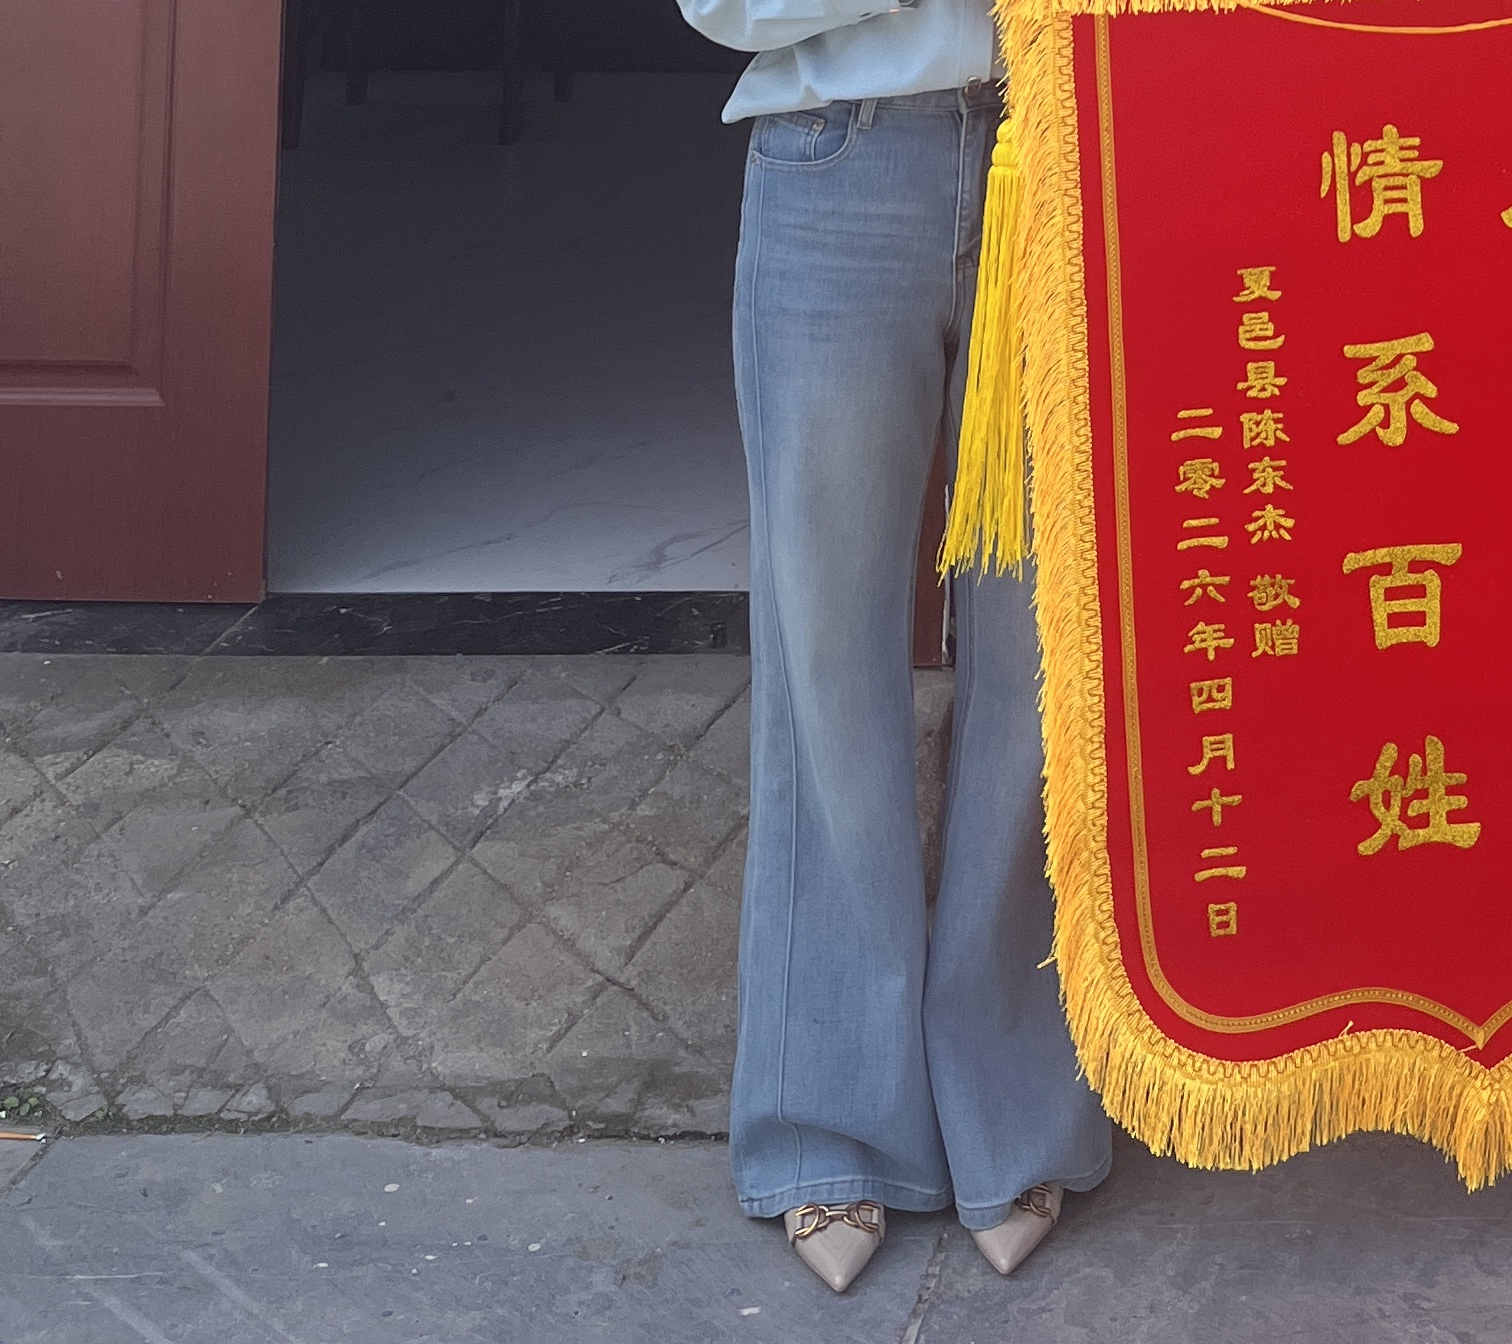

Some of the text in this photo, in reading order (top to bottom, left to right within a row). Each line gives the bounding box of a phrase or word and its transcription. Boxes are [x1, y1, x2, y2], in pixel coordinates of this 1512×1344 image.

[1169, 407, 1248, 938] 二零二六年四月十二日
[1232, 266, 1302, 659] 夏邑县陈东杰 敬赠
[1320, 124, 1481, 856] 情系百姓
